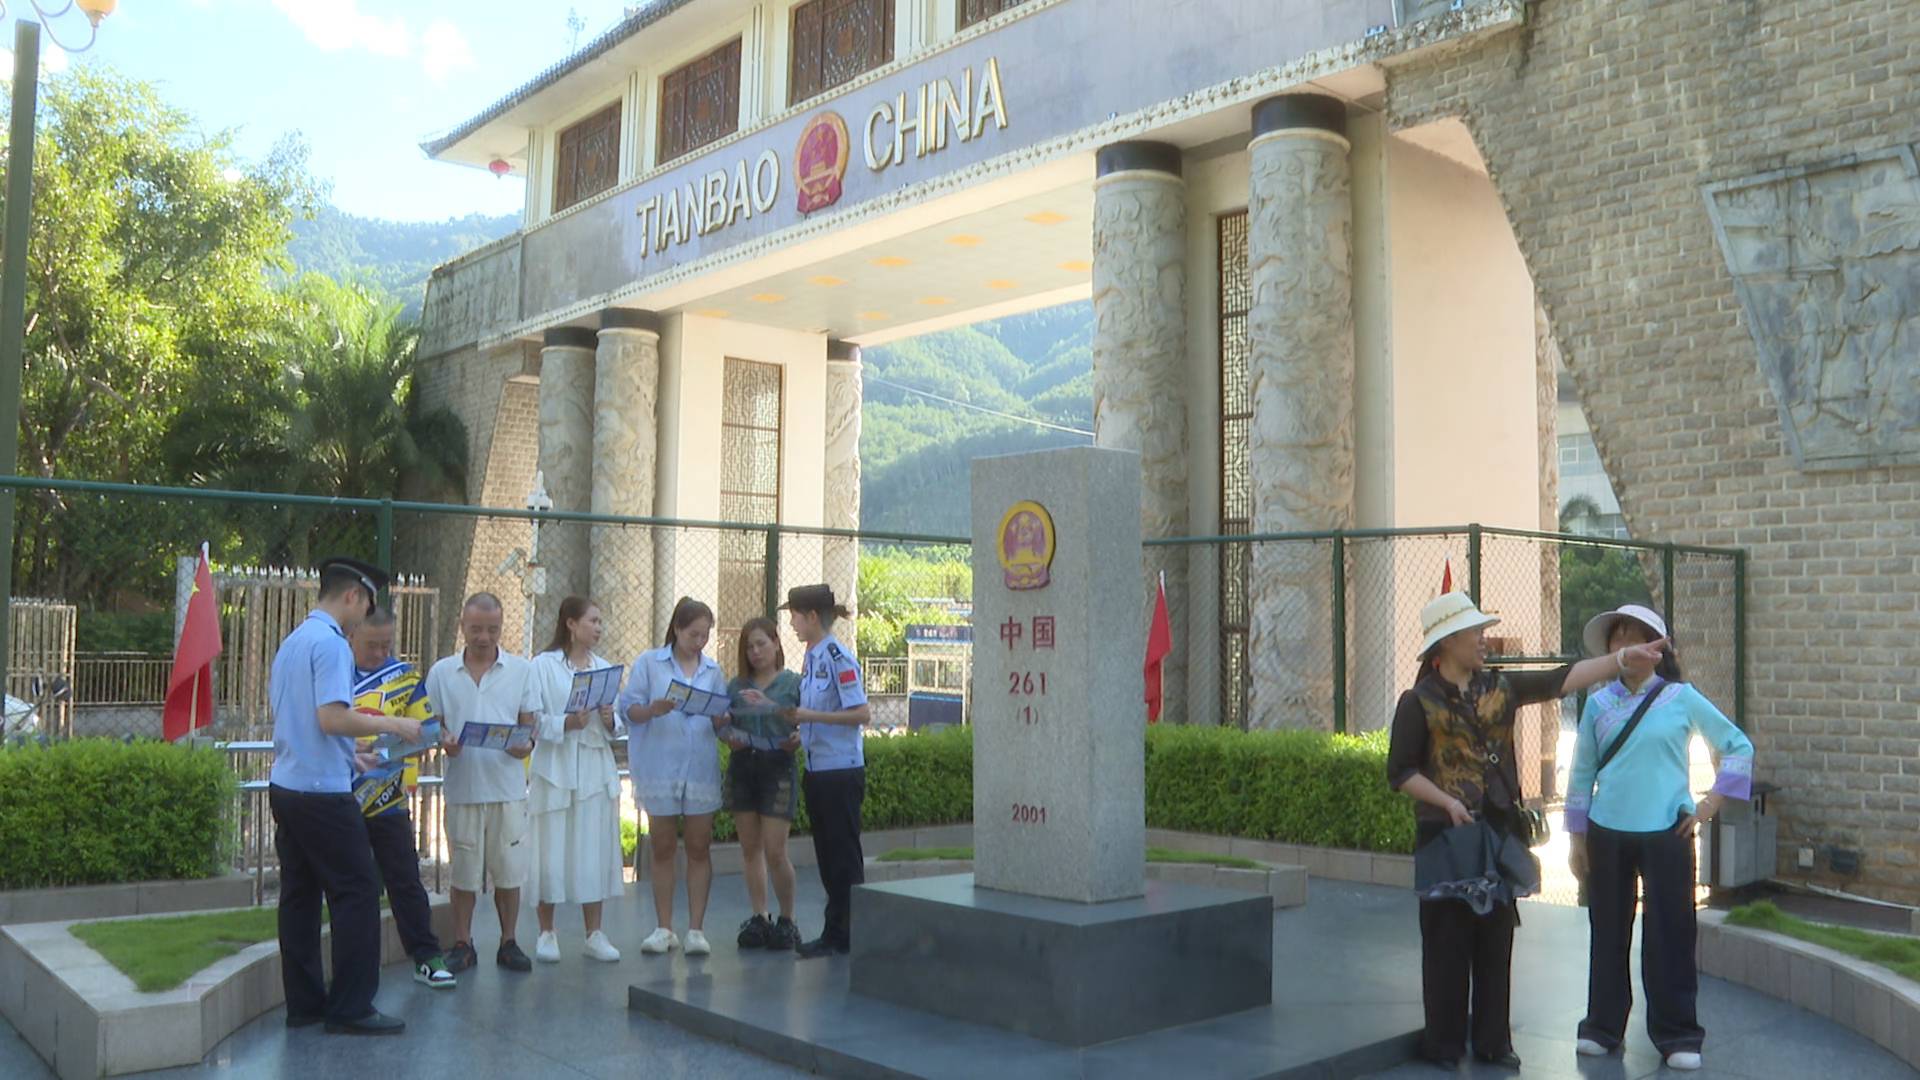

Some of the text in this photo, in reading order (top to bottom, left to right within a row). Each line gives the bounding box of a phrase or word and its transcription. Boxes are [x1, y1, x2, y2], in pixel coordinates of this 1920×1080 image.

[636, 56, 1008, 258] TIANBAO CHINA
[1000, 615, 1055, 651] 中国
[1008, 671, 1047, 696] 261
[1012, 803, 1047, 825] 2001
